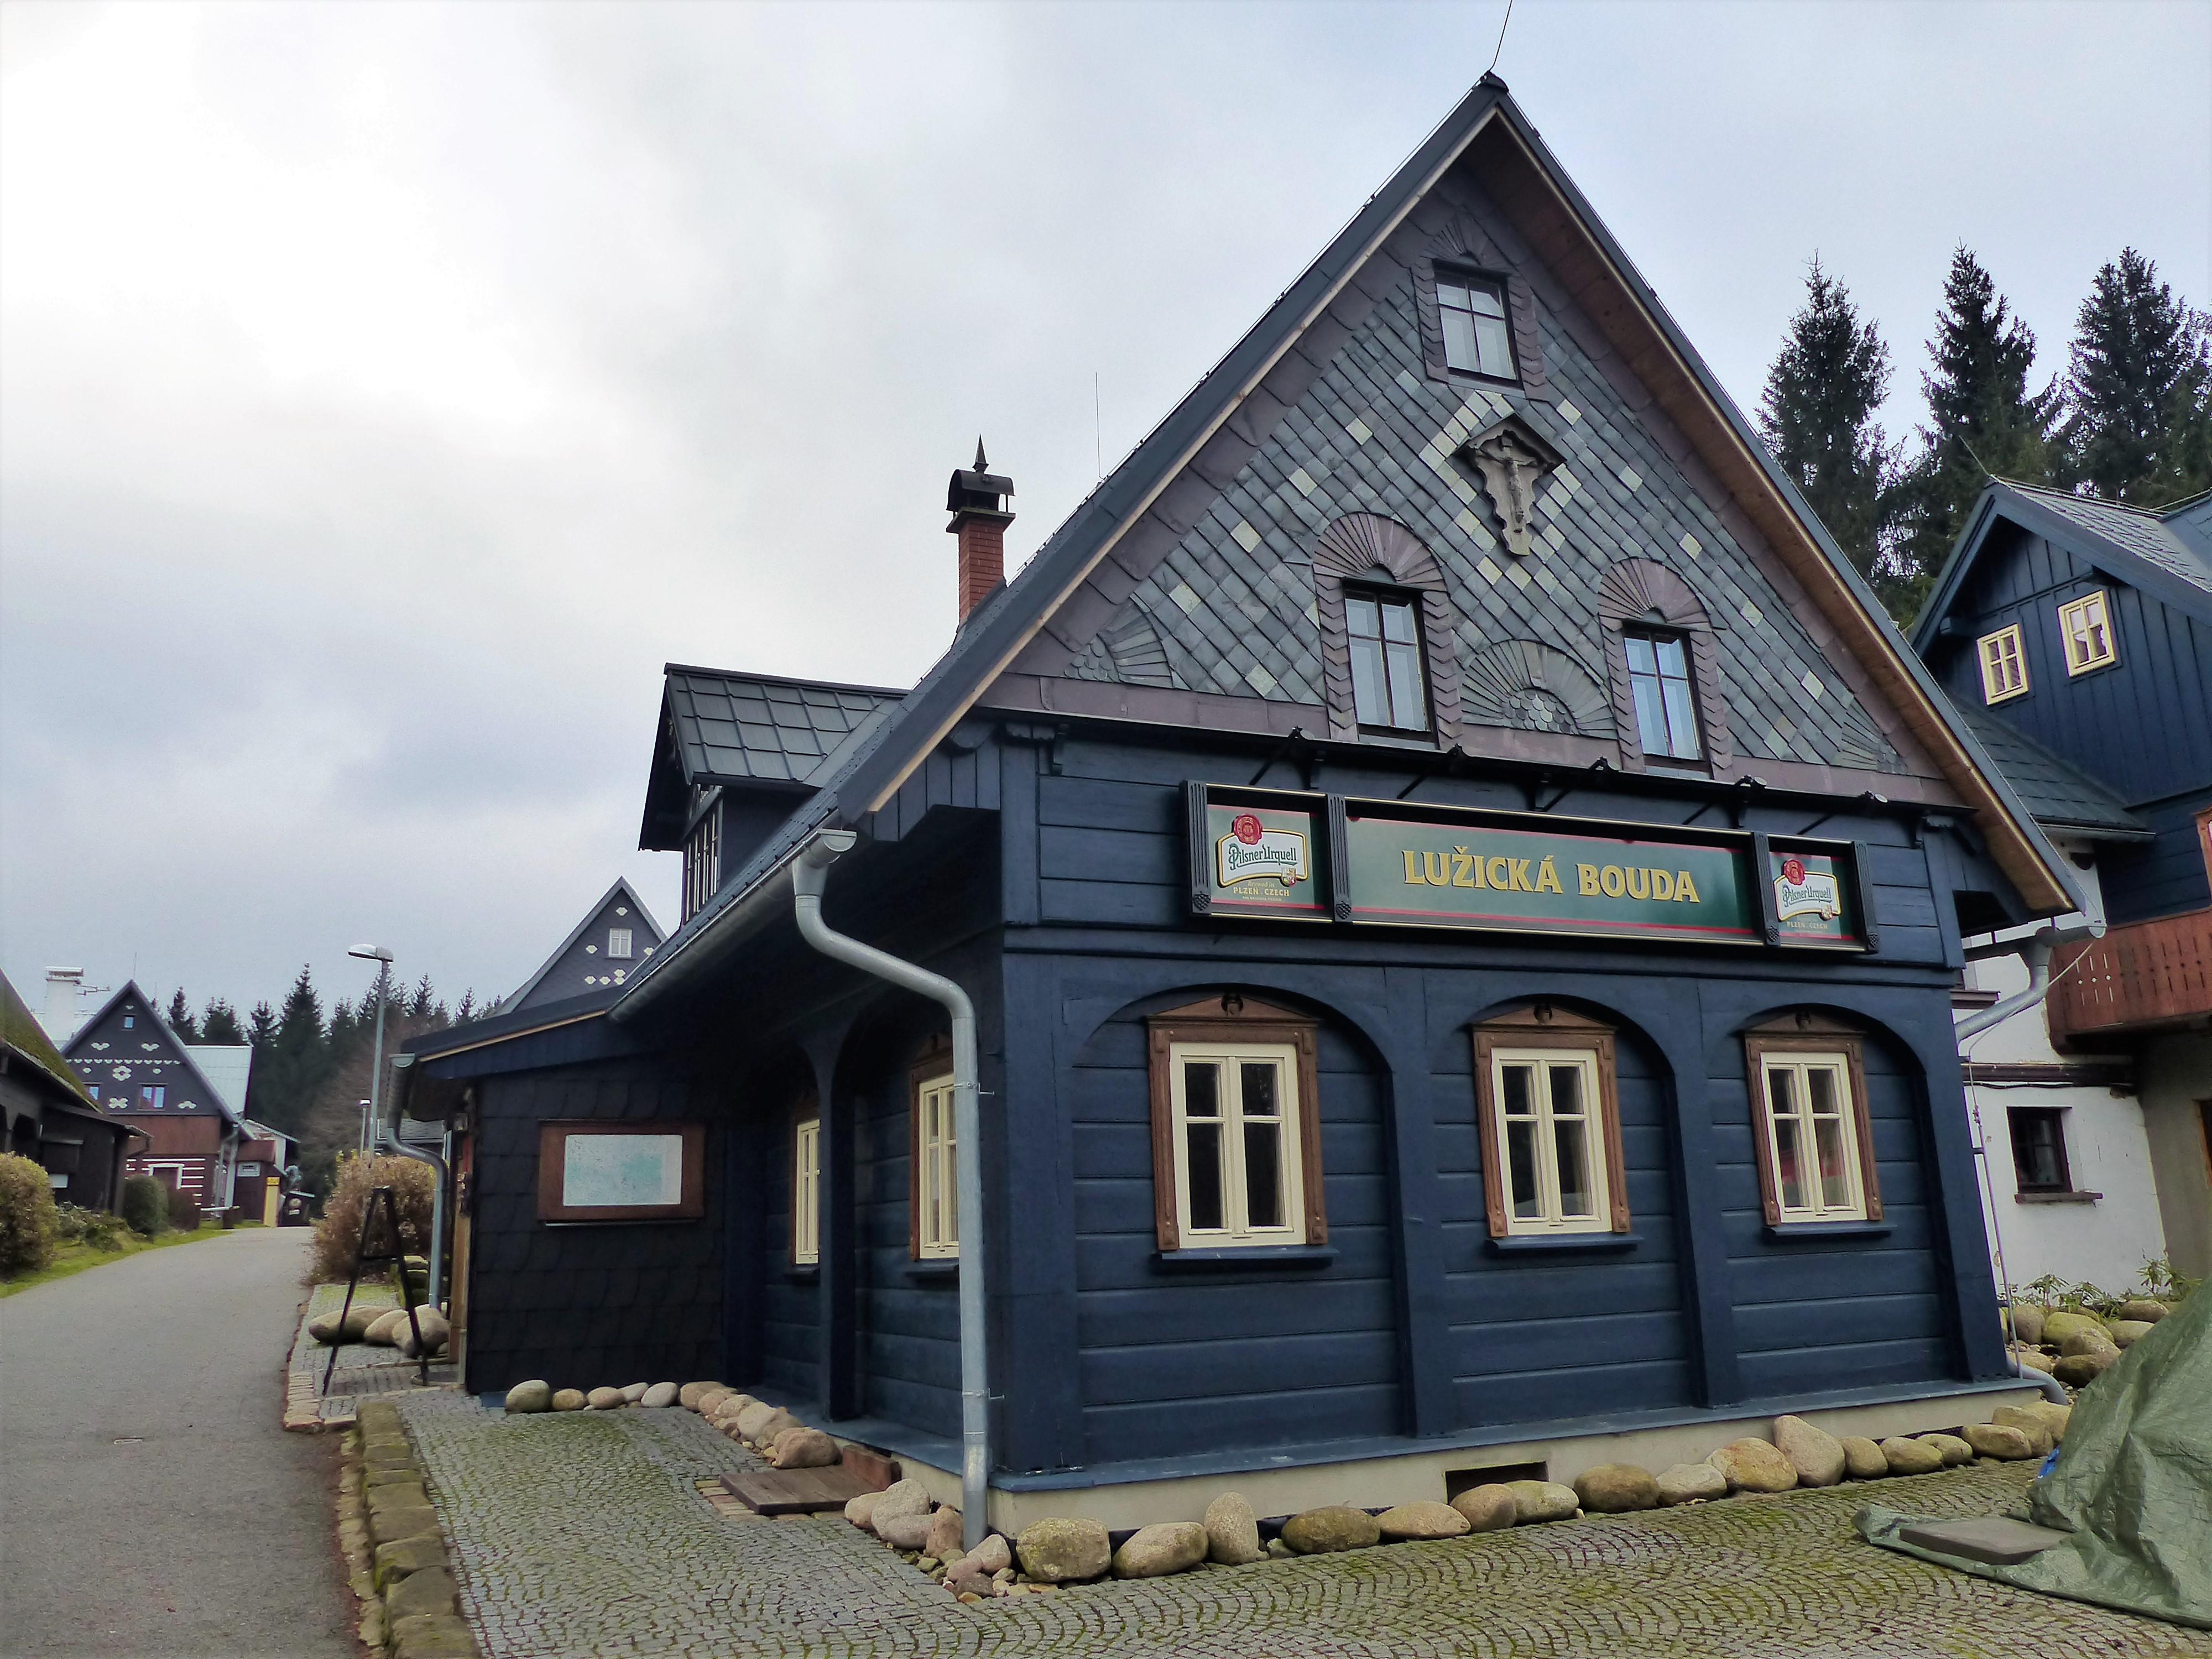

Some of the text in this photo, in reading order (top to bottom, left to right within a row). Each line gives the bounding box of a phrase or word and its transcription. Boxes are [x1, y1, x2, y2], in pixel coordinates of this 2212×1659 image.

[1229, 843, 1297, 870] Pilsner Urquell
[1402, 846, 1700, 903] LUŽICKÁ BOUDA
[1264, 888, 1290, 896] CZECH
[1782, 884, 1832, 907] Pilsner Urquell
